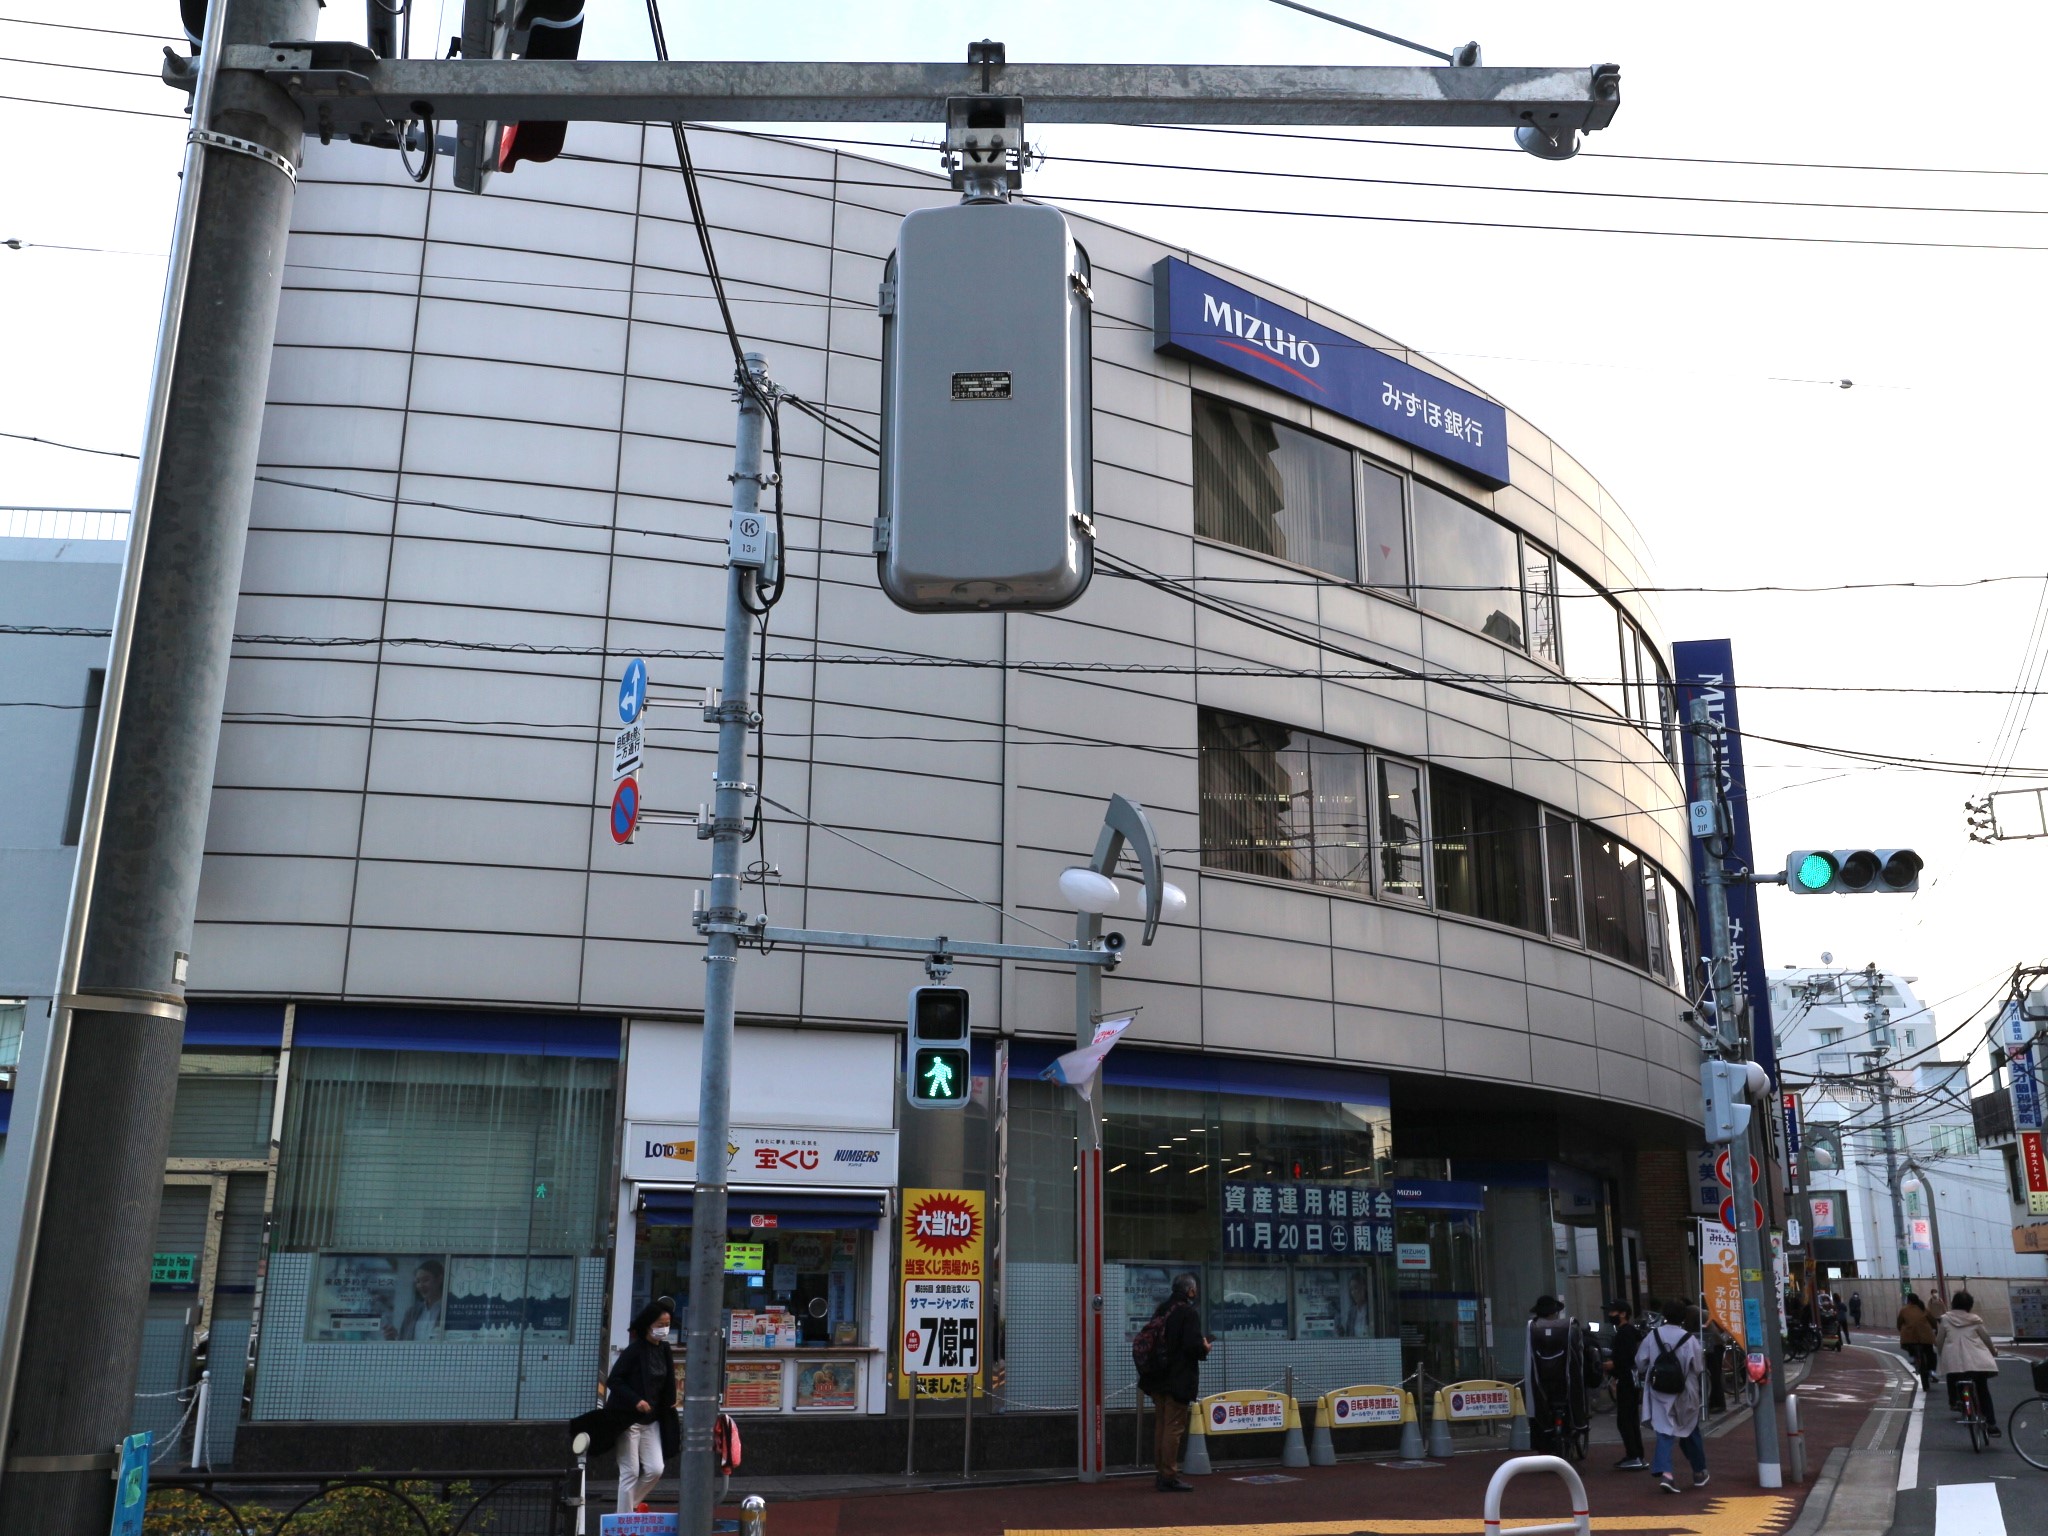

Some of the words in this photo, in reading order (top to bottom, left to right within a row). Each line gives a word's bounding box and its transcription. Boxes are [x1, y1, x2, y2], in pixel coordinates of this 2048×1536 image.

[1203, 293, 1320, 368] MIZUHO
[1382, 381, 1484, 448] みずほ銀行
[616, 739, 641, 759] 一方通行
[645, 1141, 674, 1158] LOTO
[680, 1147, 693, 1155] ロト
[833, 1149, 880, 1163] NUMBERS
[754, 1148, 819, 1170] 宝くじ
[2029, 1137, 2041, 1187] メガネストアー
[1397, 1189, 1422, 1197] MIZUHO
[1225, 1186, 1392, 1218] 資産運用相談会
[916, 1210, 971, 1237] 大当たり
[905, 1259, 980, 1275] 当宝くじ売場から
[935, 1285, 971, 1294] 全国自治宝くじ
[910, 1297, 975, 1310] サマージャンボで
[919, 1317, 978, 1368] 7億円
[1350, 1398, 1399, 1411] 自転車等放置禁止
[1465, 1392, 1509, 1405] 自転車等放置禁止
[1229, 1403, 1282, 1417] 自転車等放置禁止
